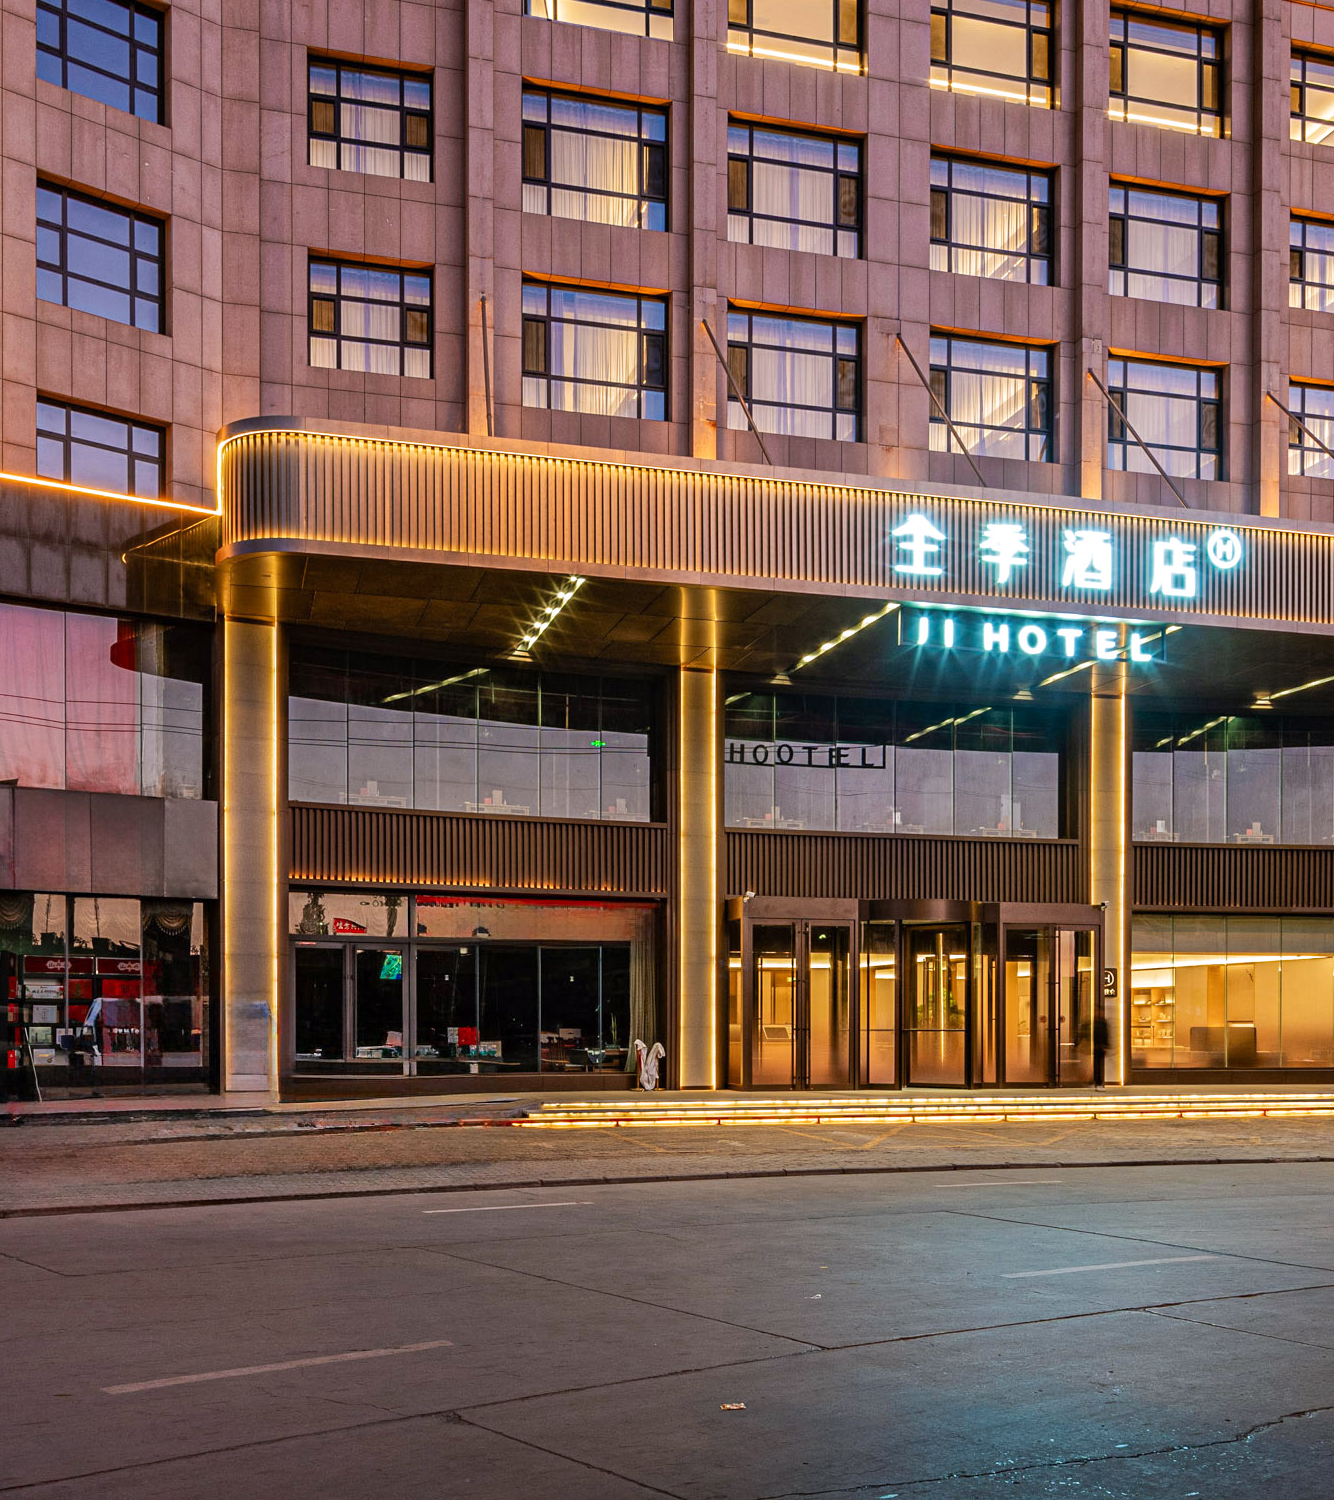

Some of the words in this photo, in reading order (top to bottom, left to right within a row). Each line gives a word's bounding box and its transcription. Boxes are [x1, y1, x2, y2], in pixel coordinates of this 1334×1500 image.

[891, 513, 1197, 598] 全季酒店
[917, 616, 954, 649] JI
[982, 621, 1153, 663] HOTEL
